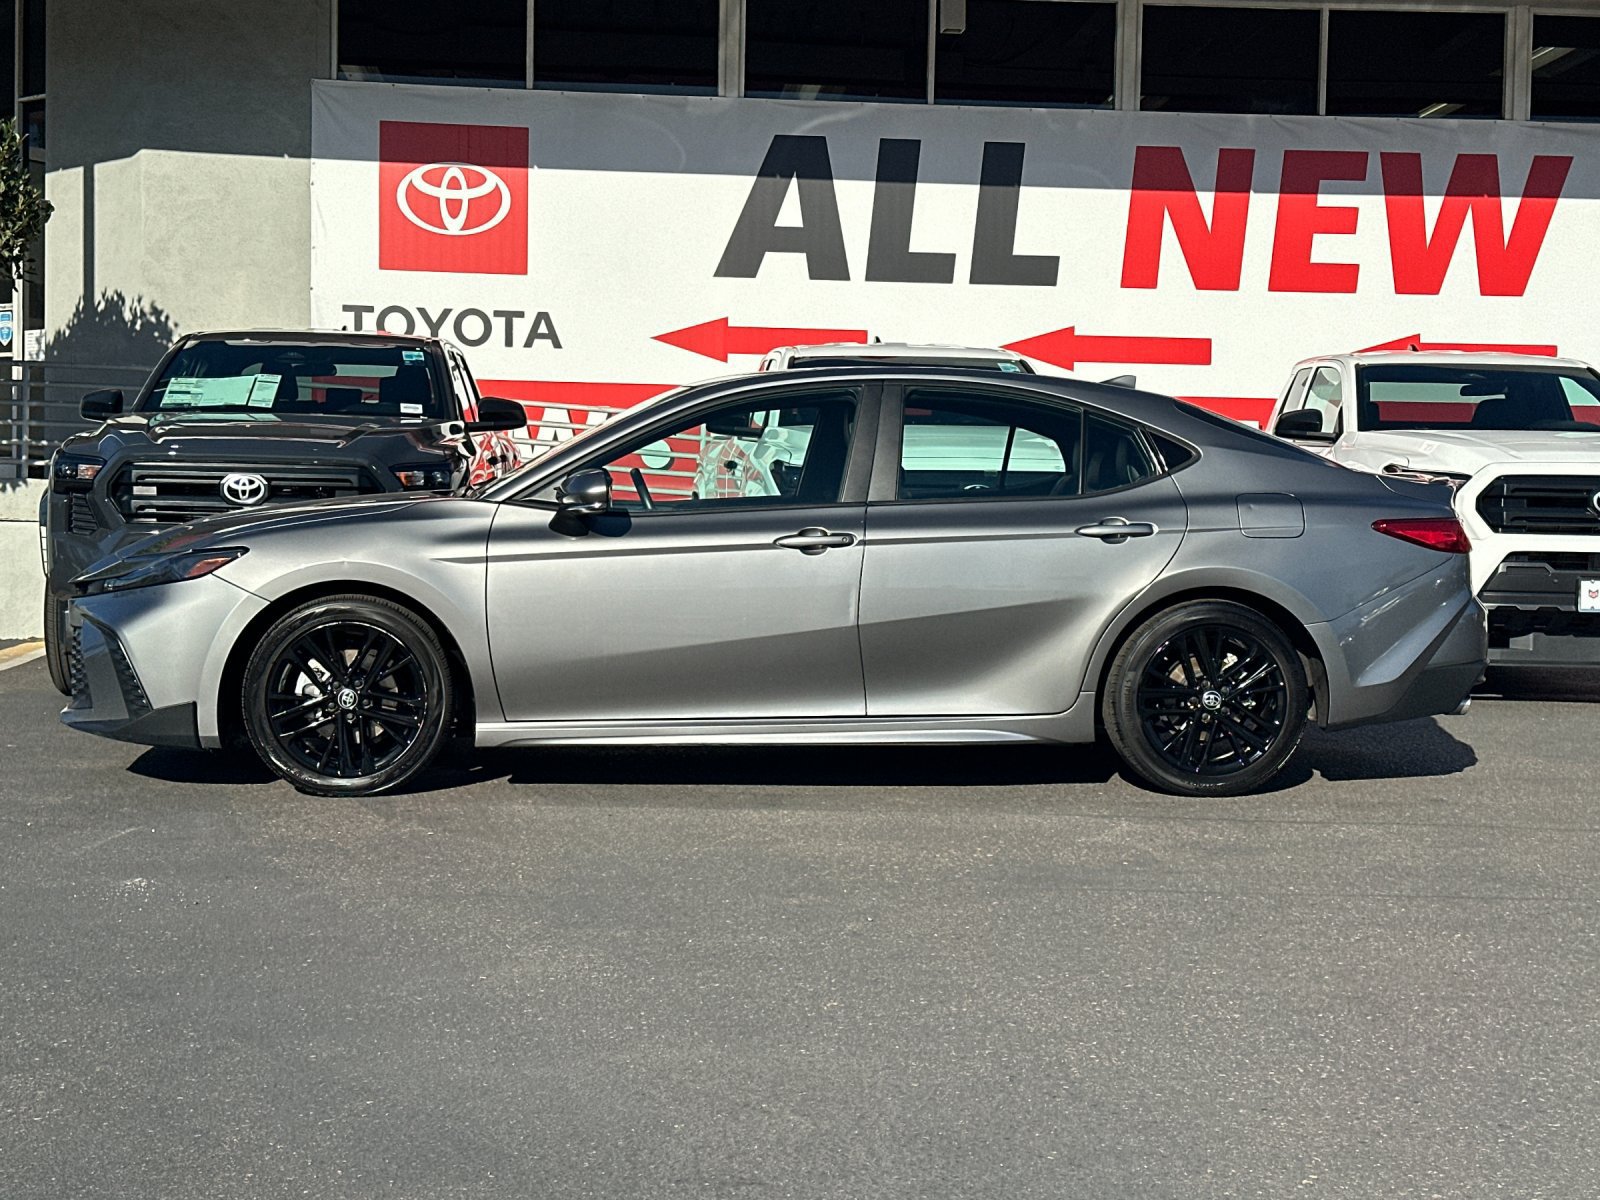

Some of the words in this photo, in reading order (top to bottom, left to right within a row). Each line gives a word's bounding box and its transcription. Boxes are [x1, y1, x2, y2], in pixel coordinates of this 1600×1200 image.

[713, 134, 1060, 287] ALL
[1120, 145, 1574, 297] NEW
[342, 304, 563, 349] TOYOTA
